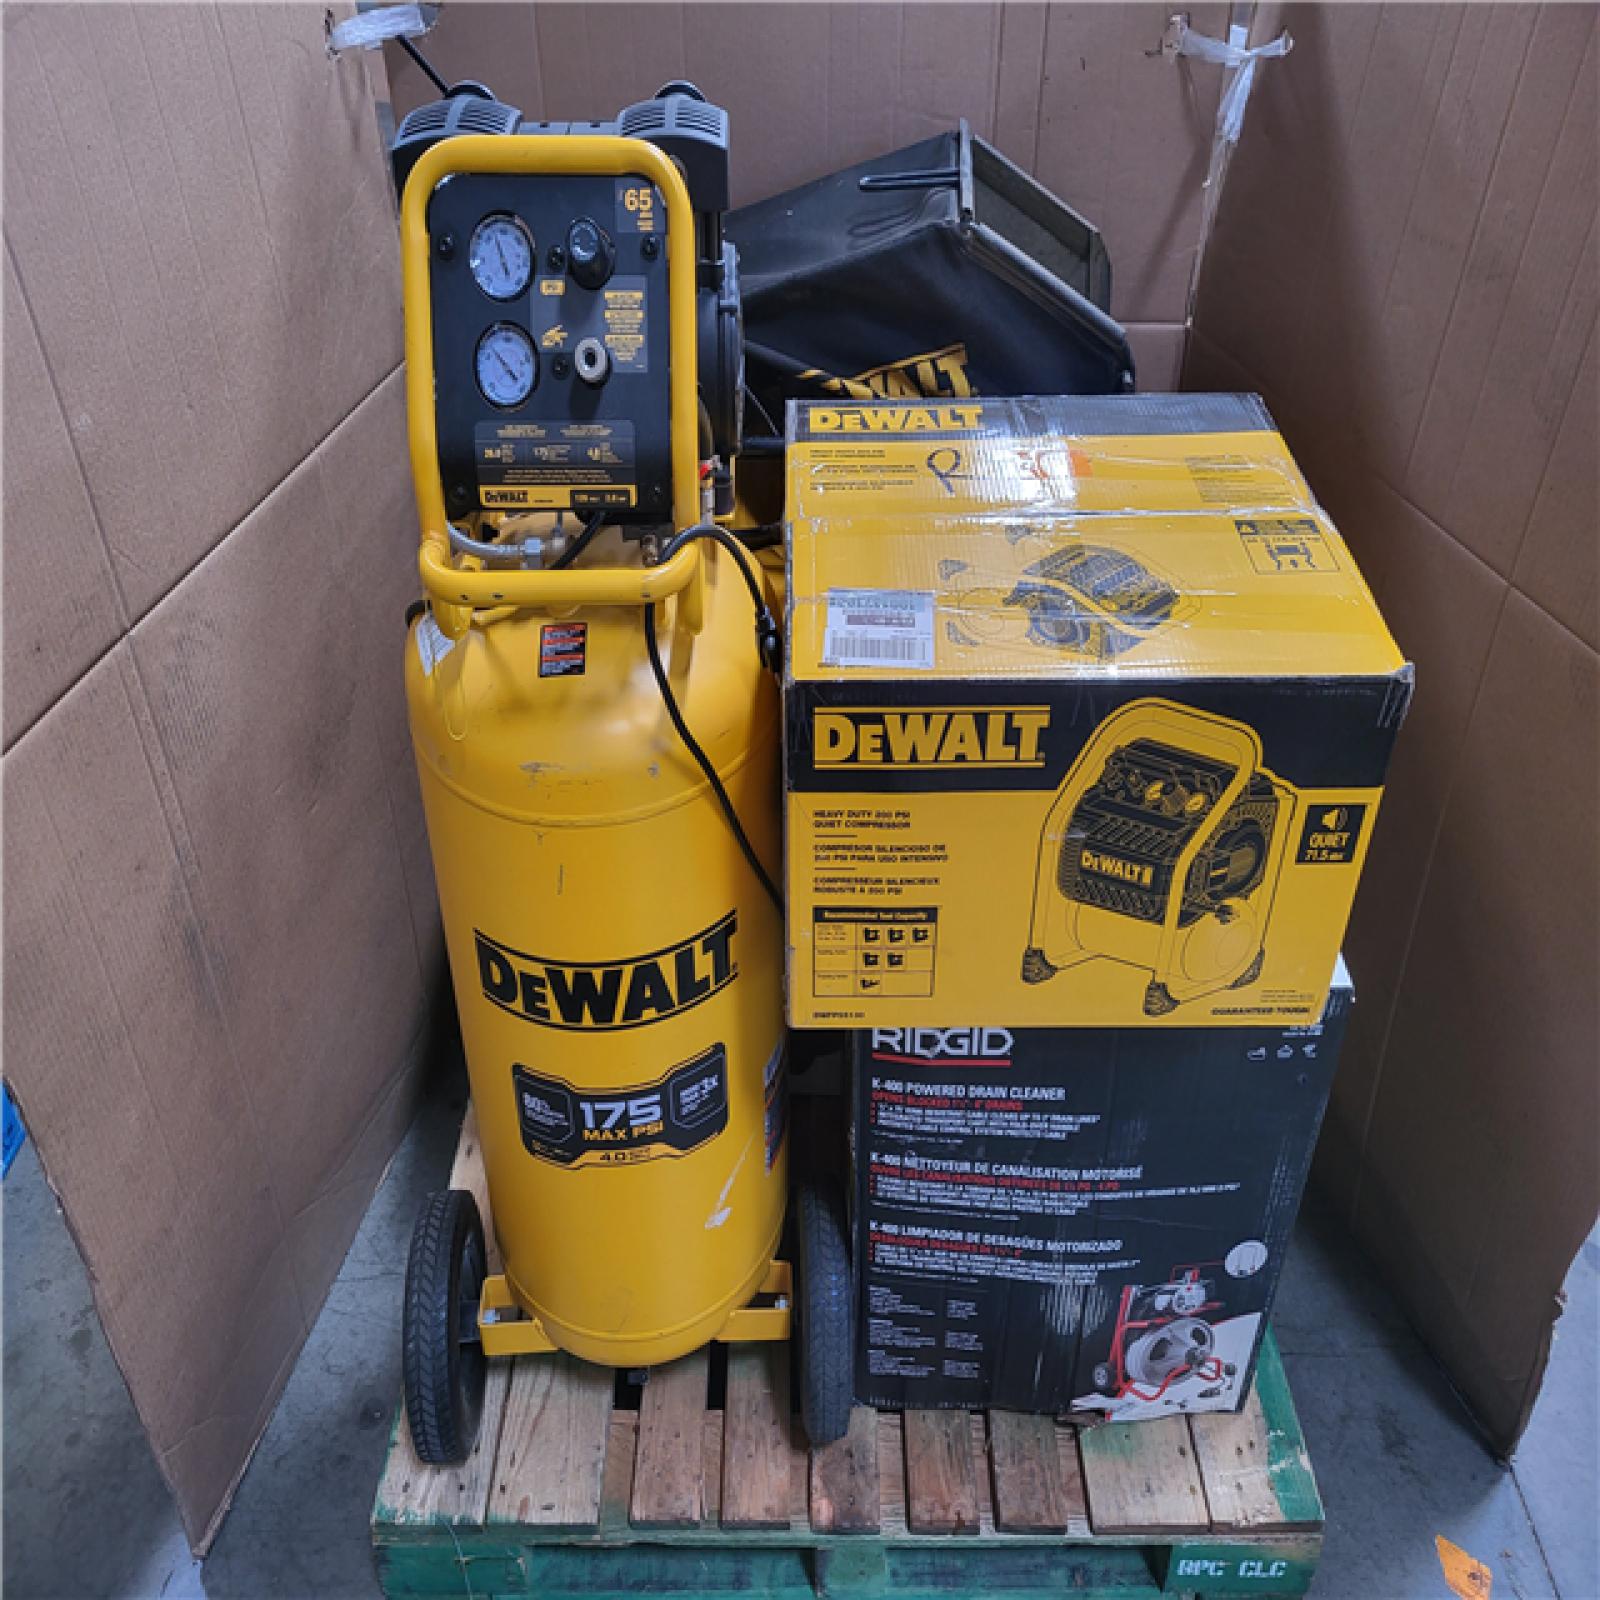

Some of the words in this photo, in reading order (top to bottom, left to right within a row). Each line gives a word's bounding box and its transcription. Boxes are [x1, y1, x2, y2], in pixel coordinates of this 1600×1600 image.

[623, 188, 653, 211] 65
[579, 1093, 662, 1130] 175
[583, 1129, 626, 1141] MAX
[632, 1122, 664, 1138] PSI
